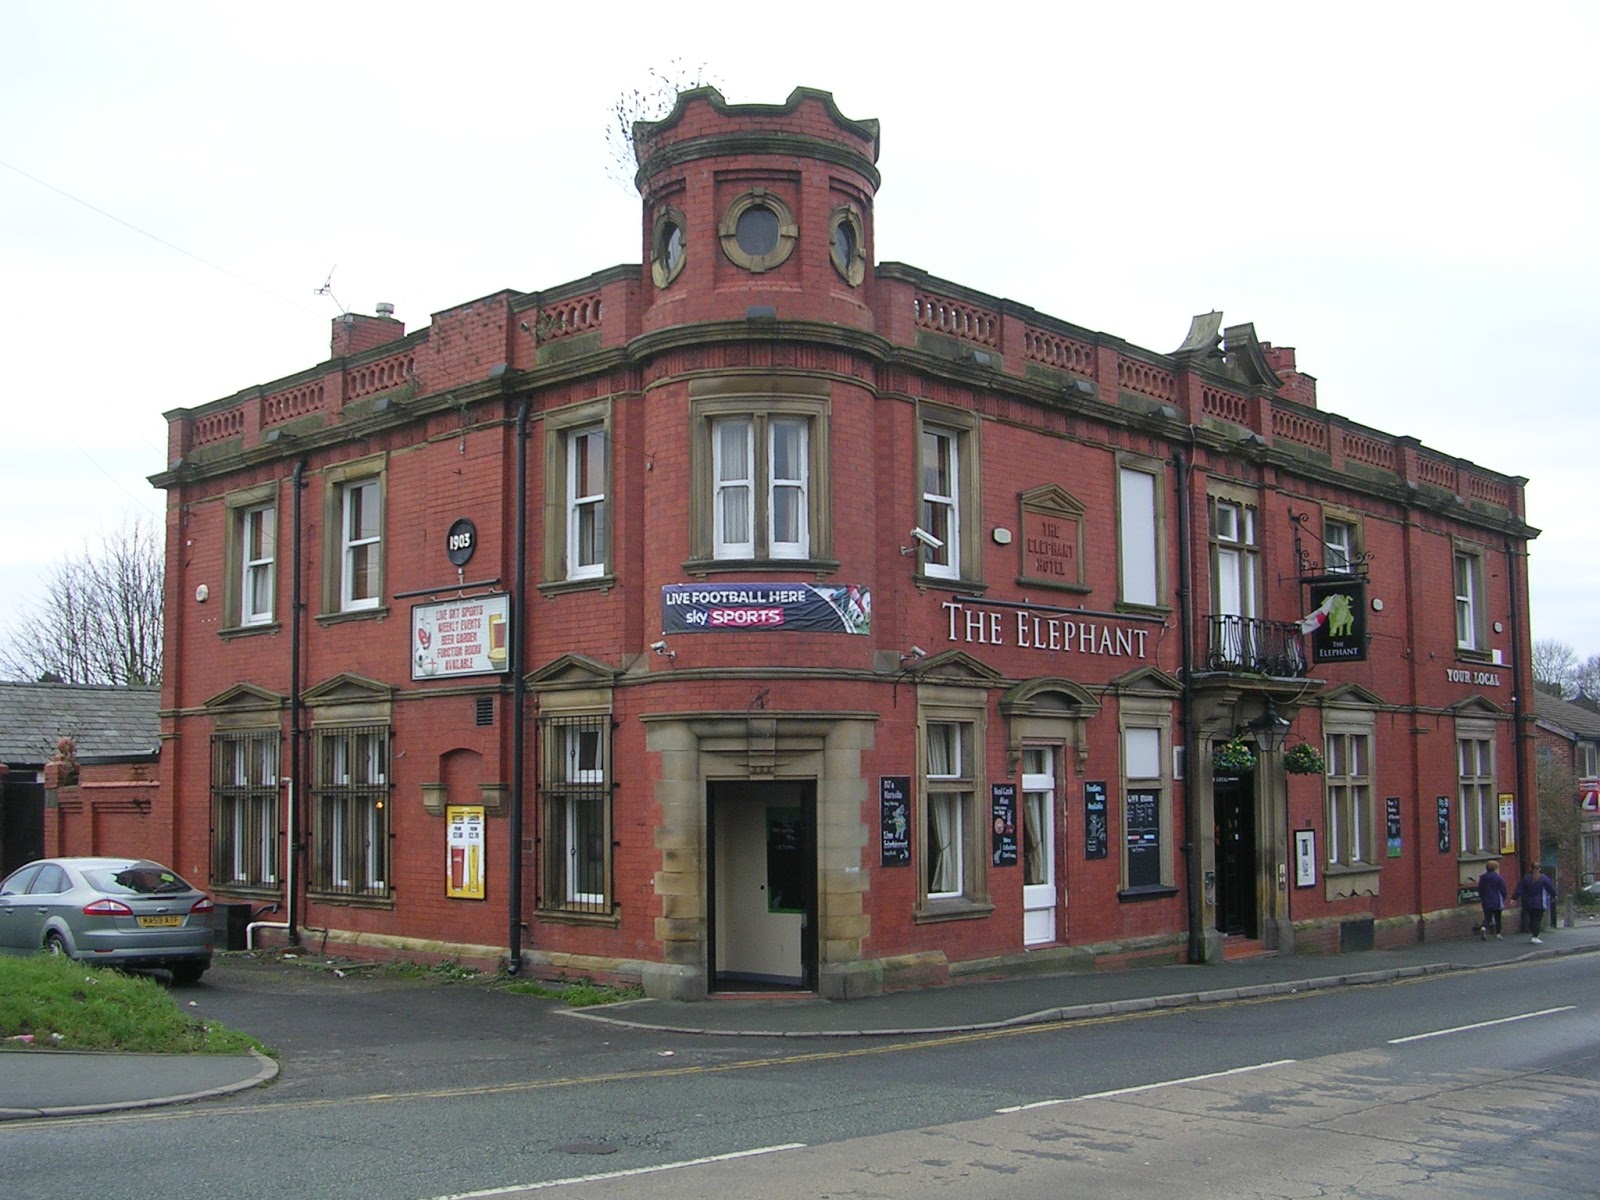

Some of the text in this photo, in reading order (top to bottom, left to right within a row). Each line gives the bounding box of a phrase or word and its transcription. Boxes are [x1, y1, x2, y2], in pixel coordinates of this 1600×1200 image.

[666, 589, 806, 605] LIVE FOOTBALL HERE
[461, 605, 484, 618] SPORTS
[685, 609, 780, 626] sky SPORTS
[460, 618, 482, 631] EVENTS
[942, 601, 1149, 659] THE ELEPHANT
[441, 632, 477, 645] BEER GARDEN
[437, 647, 463, 658] FUNCTION
[1320, 647, 1358, 657] ELEPHANT
[445, 657, 474, 671] AVAILABLE
[1446, 668, 1500, 687] YOUR LOCAL
